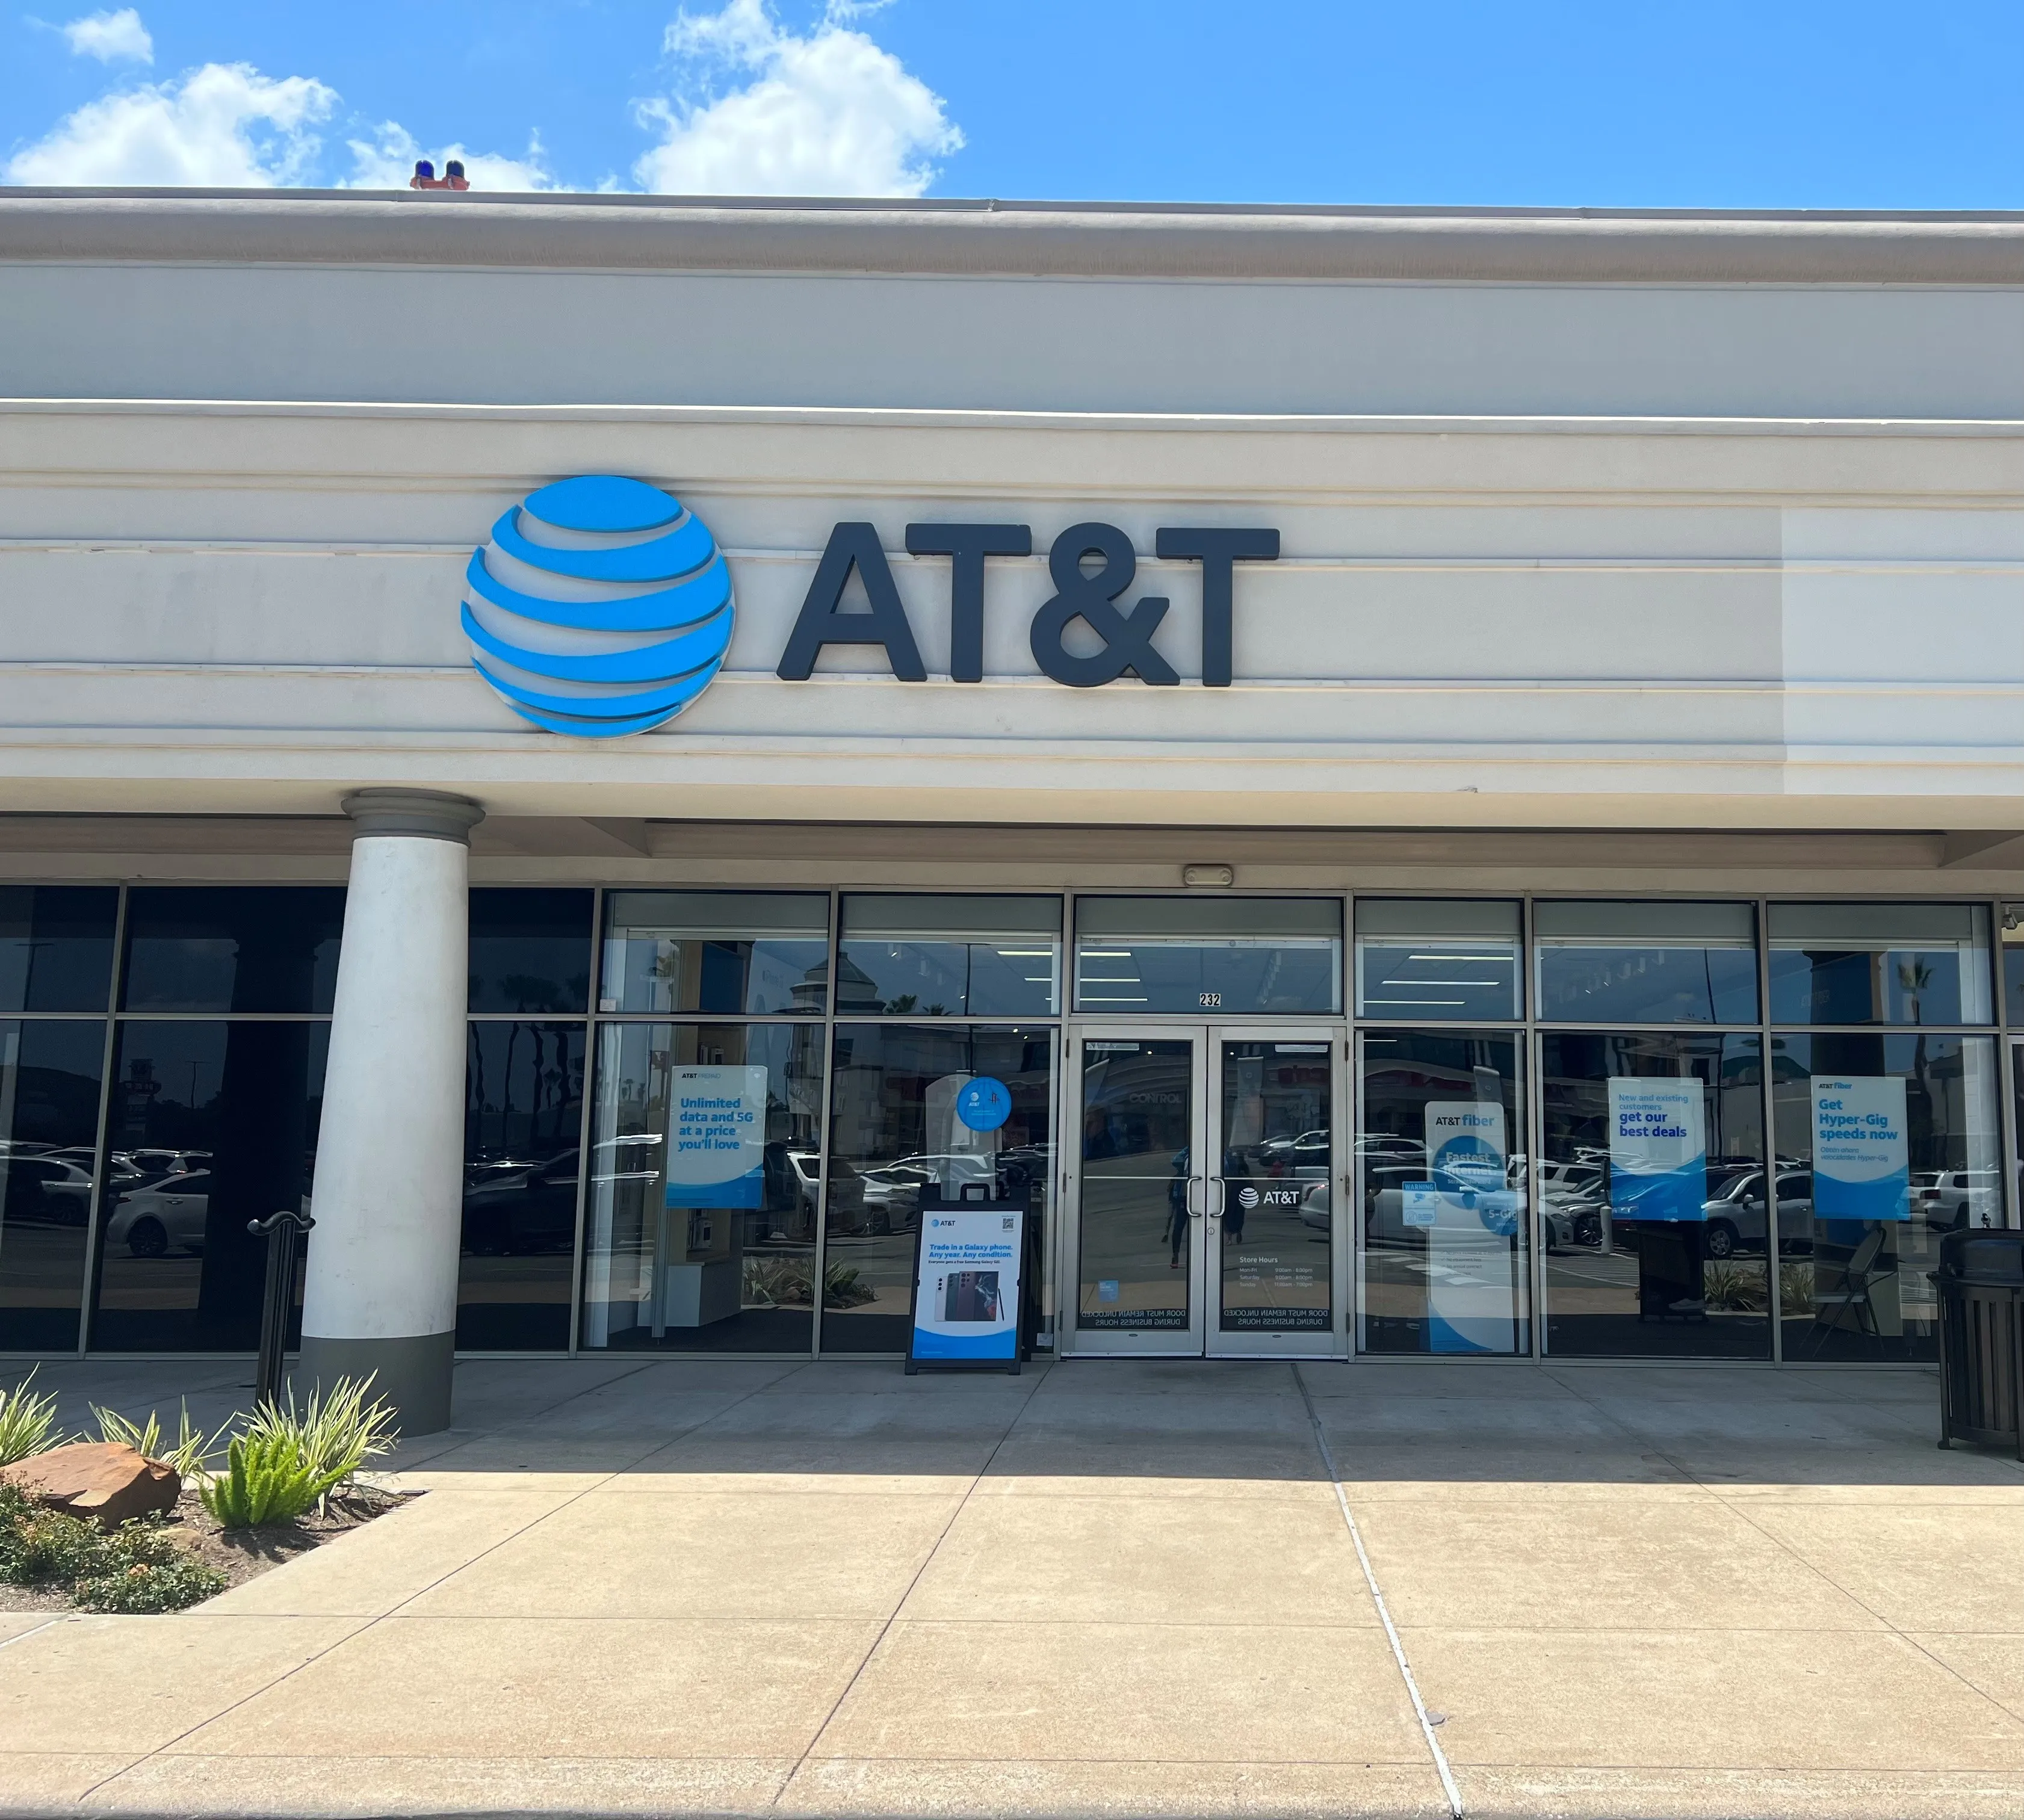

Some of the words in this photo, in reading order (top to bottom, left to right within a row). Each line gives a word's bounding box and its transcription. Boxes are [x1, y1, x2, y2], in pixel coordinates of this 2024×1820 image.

[776, 522, 1280, 687] AT&T
[1200, 994, 1220, 1006] 232
[680, 1098, 741, 1109] Unlimited
[1656, 1094, 1689, 1104] existing
[1819, 1098, 1843, 1110] Get
[679, 1112, 708, 1122] data
[711, 1112, 734, 1122] and
[737, 1112, 753, 1122] 5G
[1435, 1116, 1461, 1126] AT&T
[1462, 1114, 1495, 1126] fiber
[1619, 1112, 1642, 1125] get
[1645, 1113, 1668, 1122] our
[1819, 1113, 1888, 1128] Hyper-Gig
[679, 1126, 692, 1136] at
[695, 1127, 702, 1136] a
[705, 1125, 736, 1138] price
[1620, 1125, 1649, 1137] best
[1652, 1125, 1687, 1138] deals
[1819, 1127, 1866, 1141] speeds
[1869, 1131, 1898, 1139] now
[678, 1139, 711, 1152] you'll
[715, 1139, 740, 1150] love
[1446, 1152, 1491, 1163] Fastest
[1263, 1191, 1299, 1204] AT&T
[965, 1243, 988, 1252] Galaxy
[989, 1243, 1013, 1252] phone.
